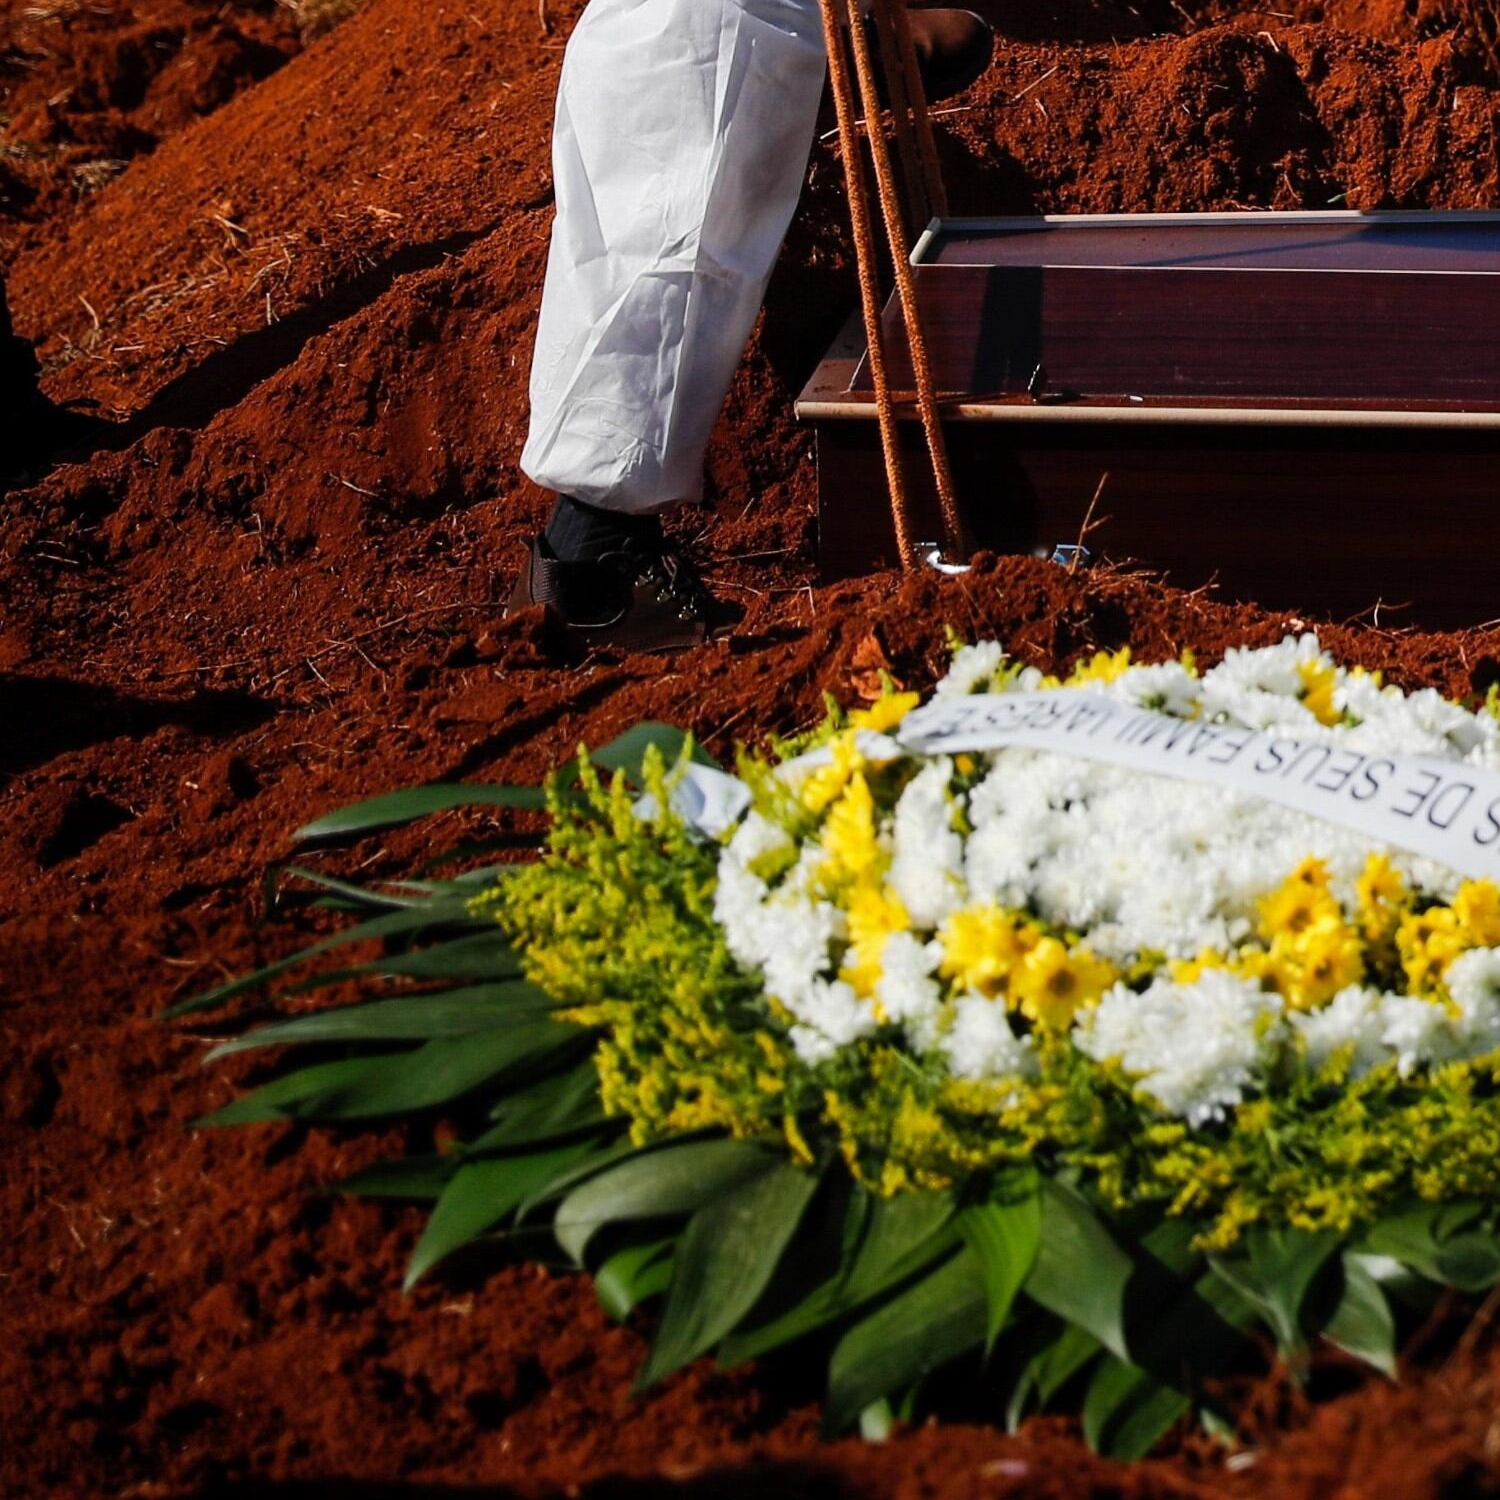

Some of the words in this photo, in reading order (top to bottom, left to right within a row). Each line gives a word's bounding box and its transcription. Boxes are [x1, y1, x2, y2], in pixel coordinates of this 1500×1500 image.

[985, 699, 1257, 764] FAMILIARES
[1254, 738, 1396, 801] SEUS
[1390, 770, 1476, 830] DE
